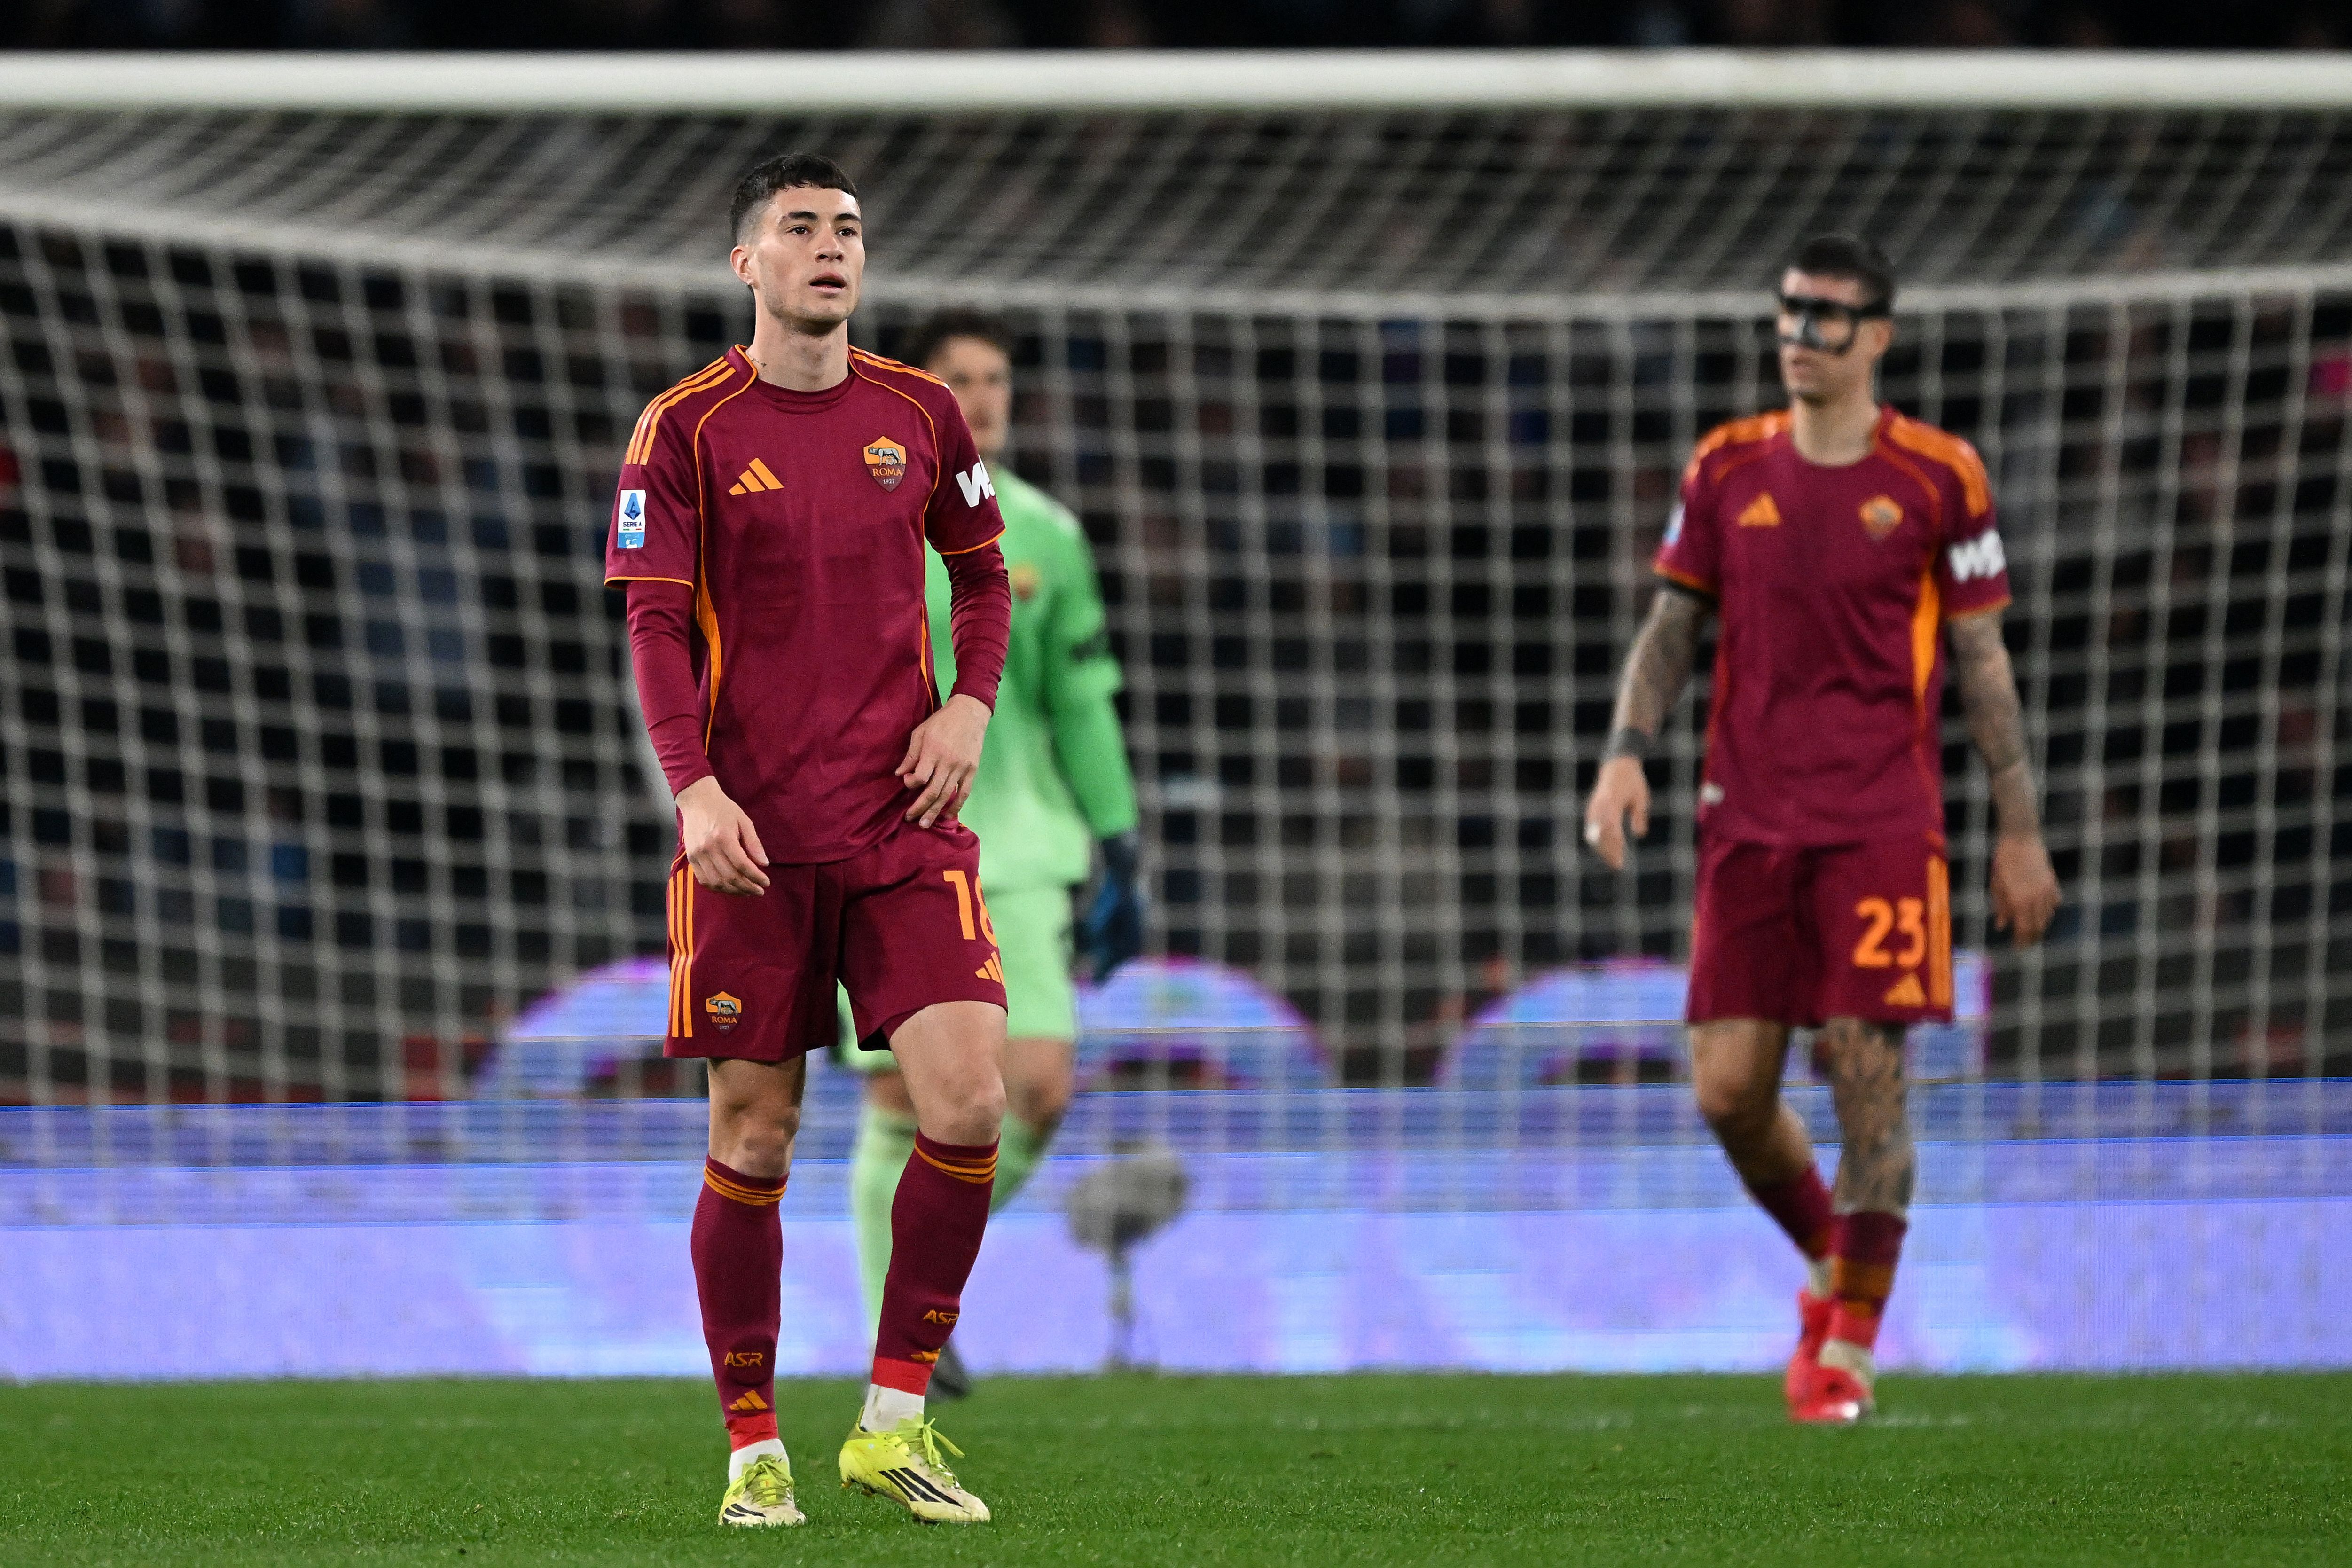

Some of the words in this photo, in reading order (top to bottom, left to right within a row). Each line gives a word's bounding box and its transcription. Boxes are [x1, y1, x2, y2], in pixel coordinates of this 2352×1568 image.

[872, 468, 902, 477] ROMA
[1853, 897, 1925, 968] 23
[724, 1351, 763, 1367] ASR
